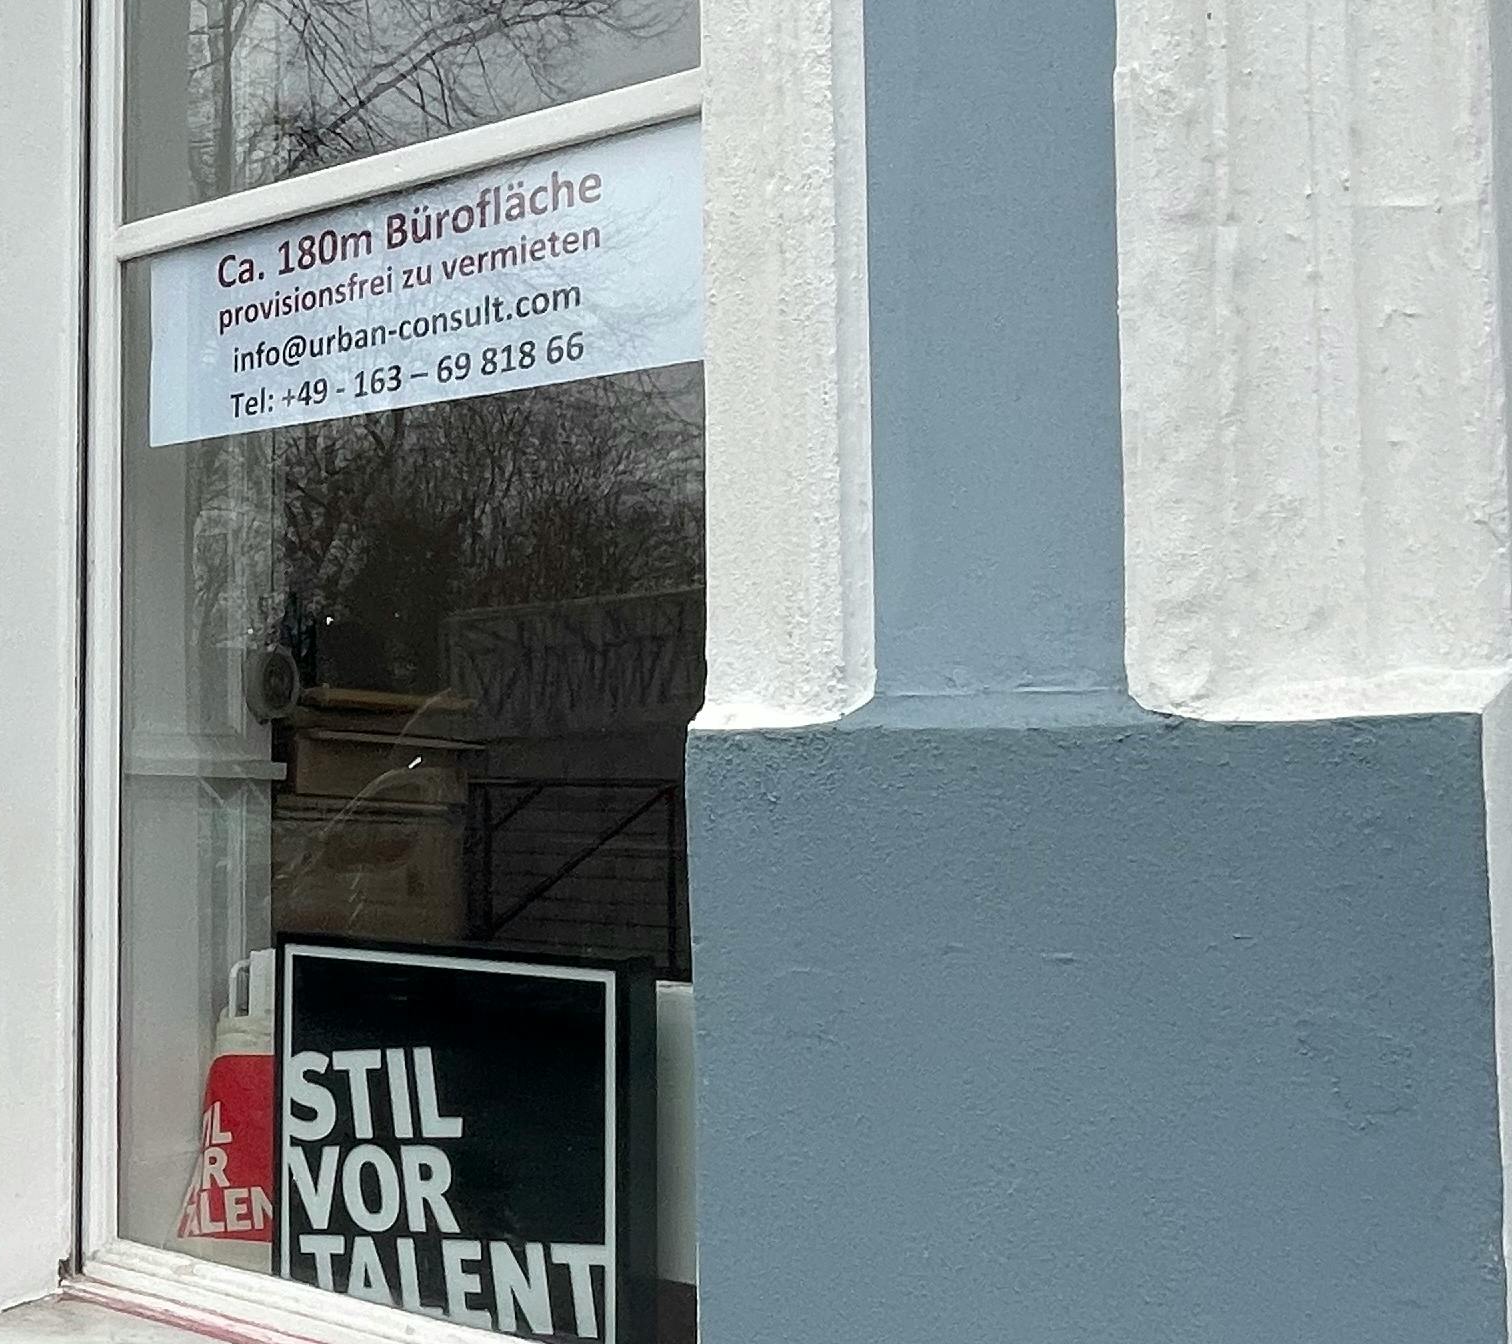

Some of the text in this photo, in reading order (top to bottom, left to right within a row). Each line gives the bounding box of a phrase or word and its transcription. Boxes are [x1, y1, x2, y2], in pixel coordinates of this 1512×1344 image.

[218, 170, 602, 288] Ca. 180m Bürofläche
[219, 226, 601, 335] provisionsfrei zu vermieten
[230, 387, 274, 418] Tel:
[282, 377, 328, 407] +49
[354, 364, 402, 398] 163
[437, 352, 472, 383] 69
[480, 340, 536, 375] 818
[546, 331, 584, 365] 66
[234, 285, 581, 373] info@urban-consult.com
[287, 1046, 464, 1141] STIL
[287, 1143, 462, 1234] VOR
[298, 1234, 606, 1340] TALENT
